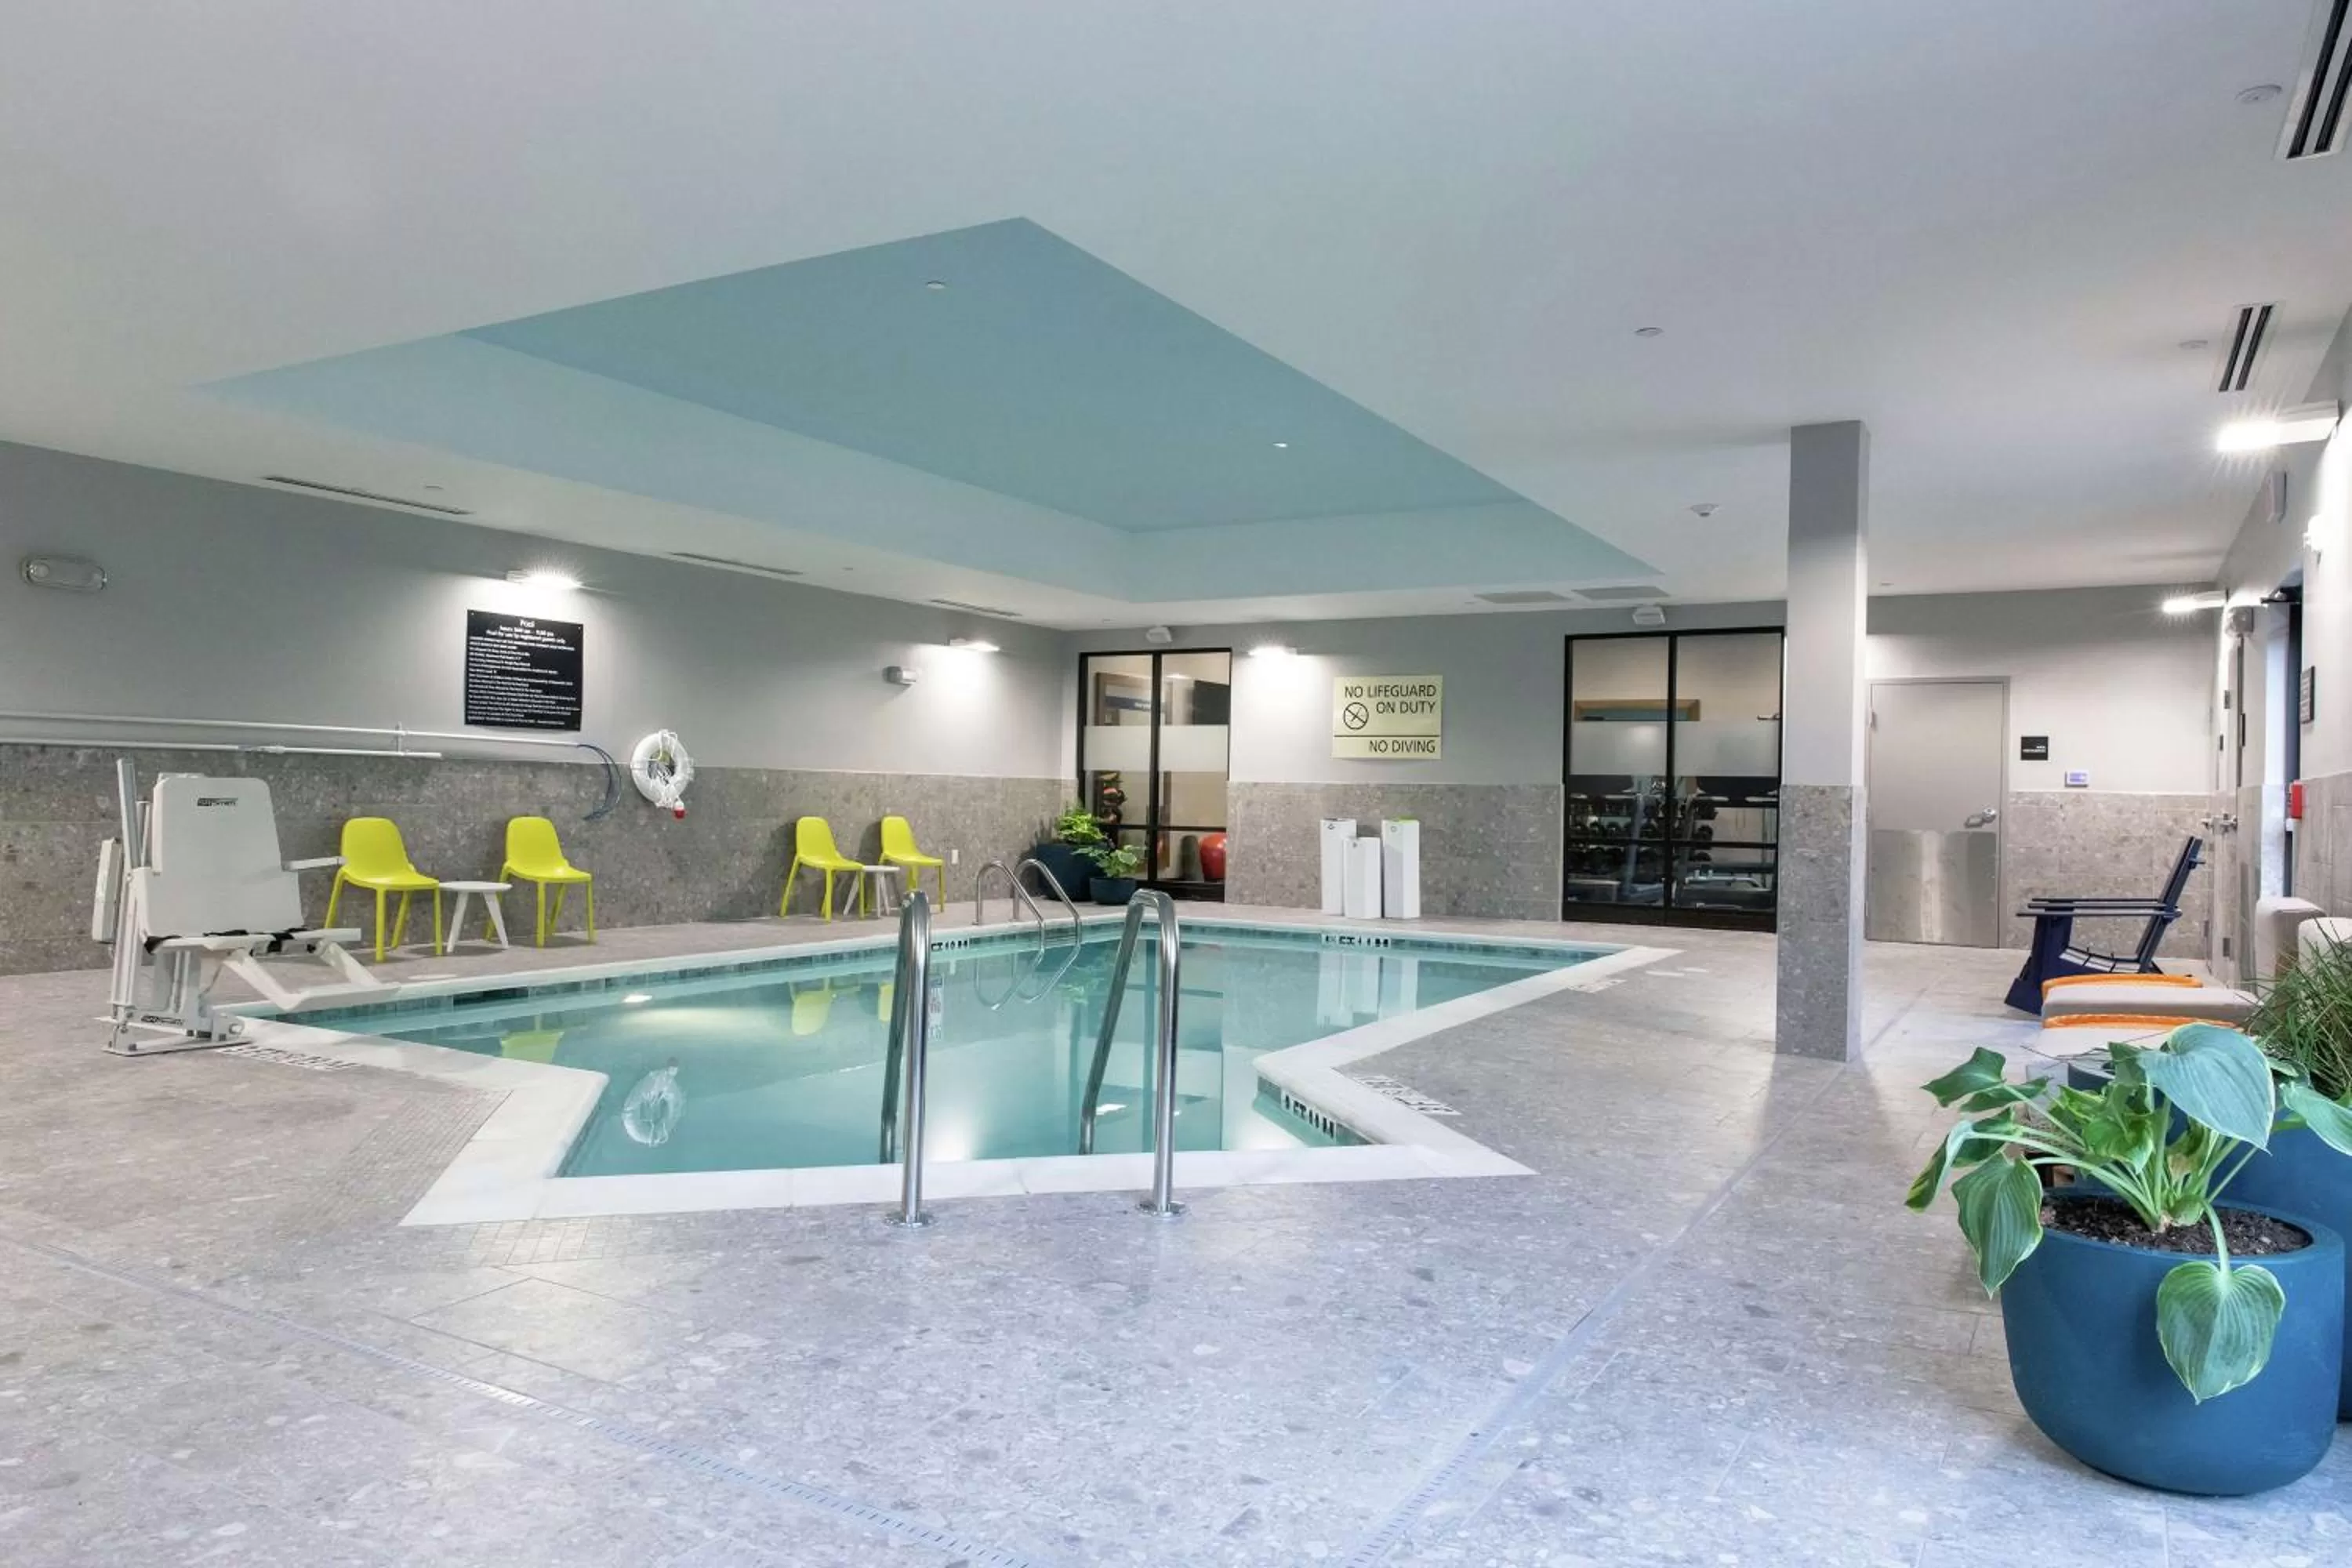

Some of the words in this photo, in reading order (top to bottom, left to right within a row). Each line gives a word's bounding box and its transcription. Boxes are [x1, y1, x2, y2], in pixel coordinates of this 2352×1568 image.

[1345, 686, 1363, 698] NO
[1367, 684, 1436, 698] LIFEGUARD
[1376, 701, 1395, 714] ON
[1399, 701, 1436, 713] DUTY
[1369, 740, 1388, 753] NO
[1392, 740, 1436, 753] DIVING
